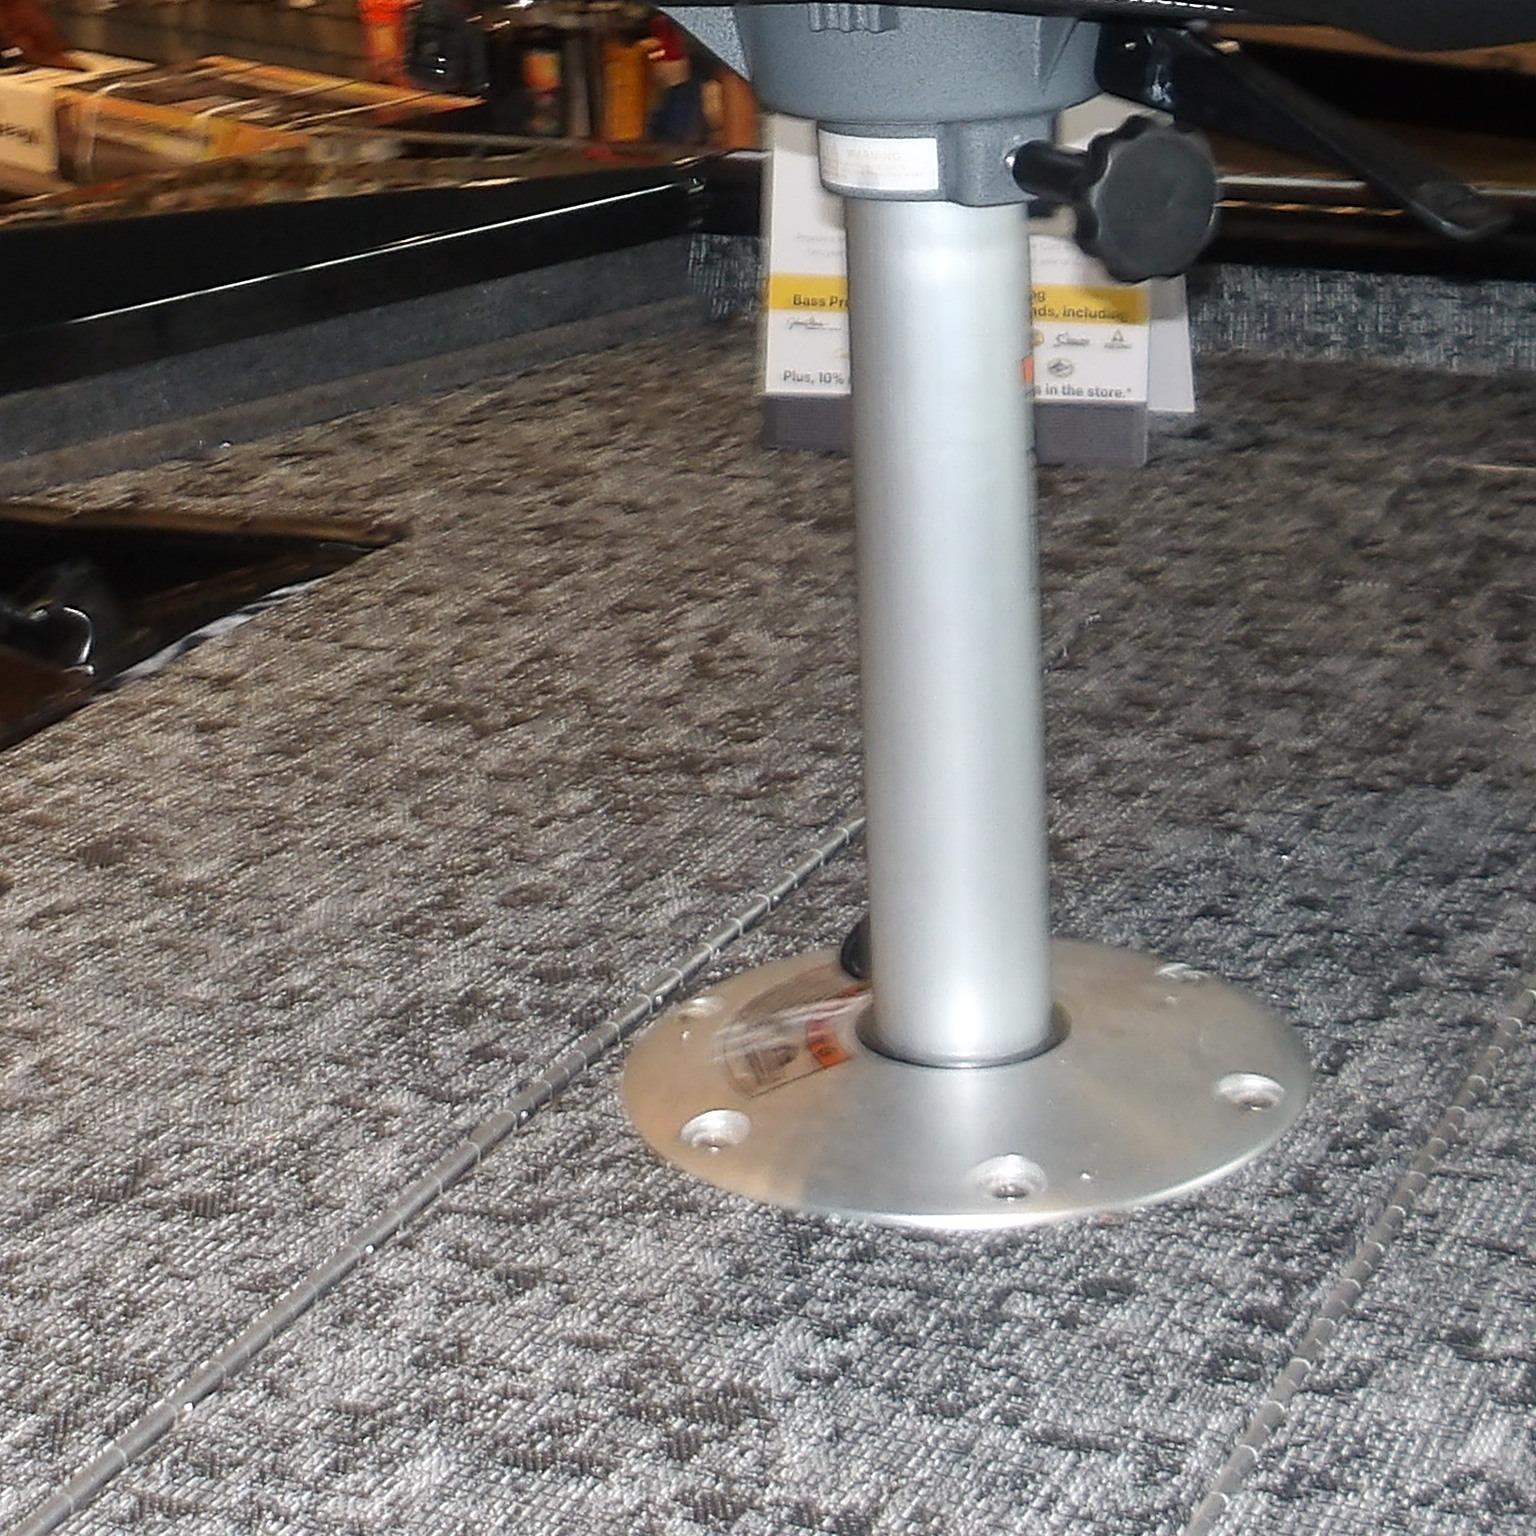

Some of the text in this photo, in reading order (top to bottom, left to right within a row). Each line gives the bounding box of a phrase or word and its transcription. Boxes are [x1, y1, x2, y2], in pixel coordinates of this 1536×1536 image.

[792, 293, 826, 307] Bass
[783, 370, 845, 386] Plus, 10%
[1046, 383, 1058, 396] in
[1061, 384, 1084, 398] the
